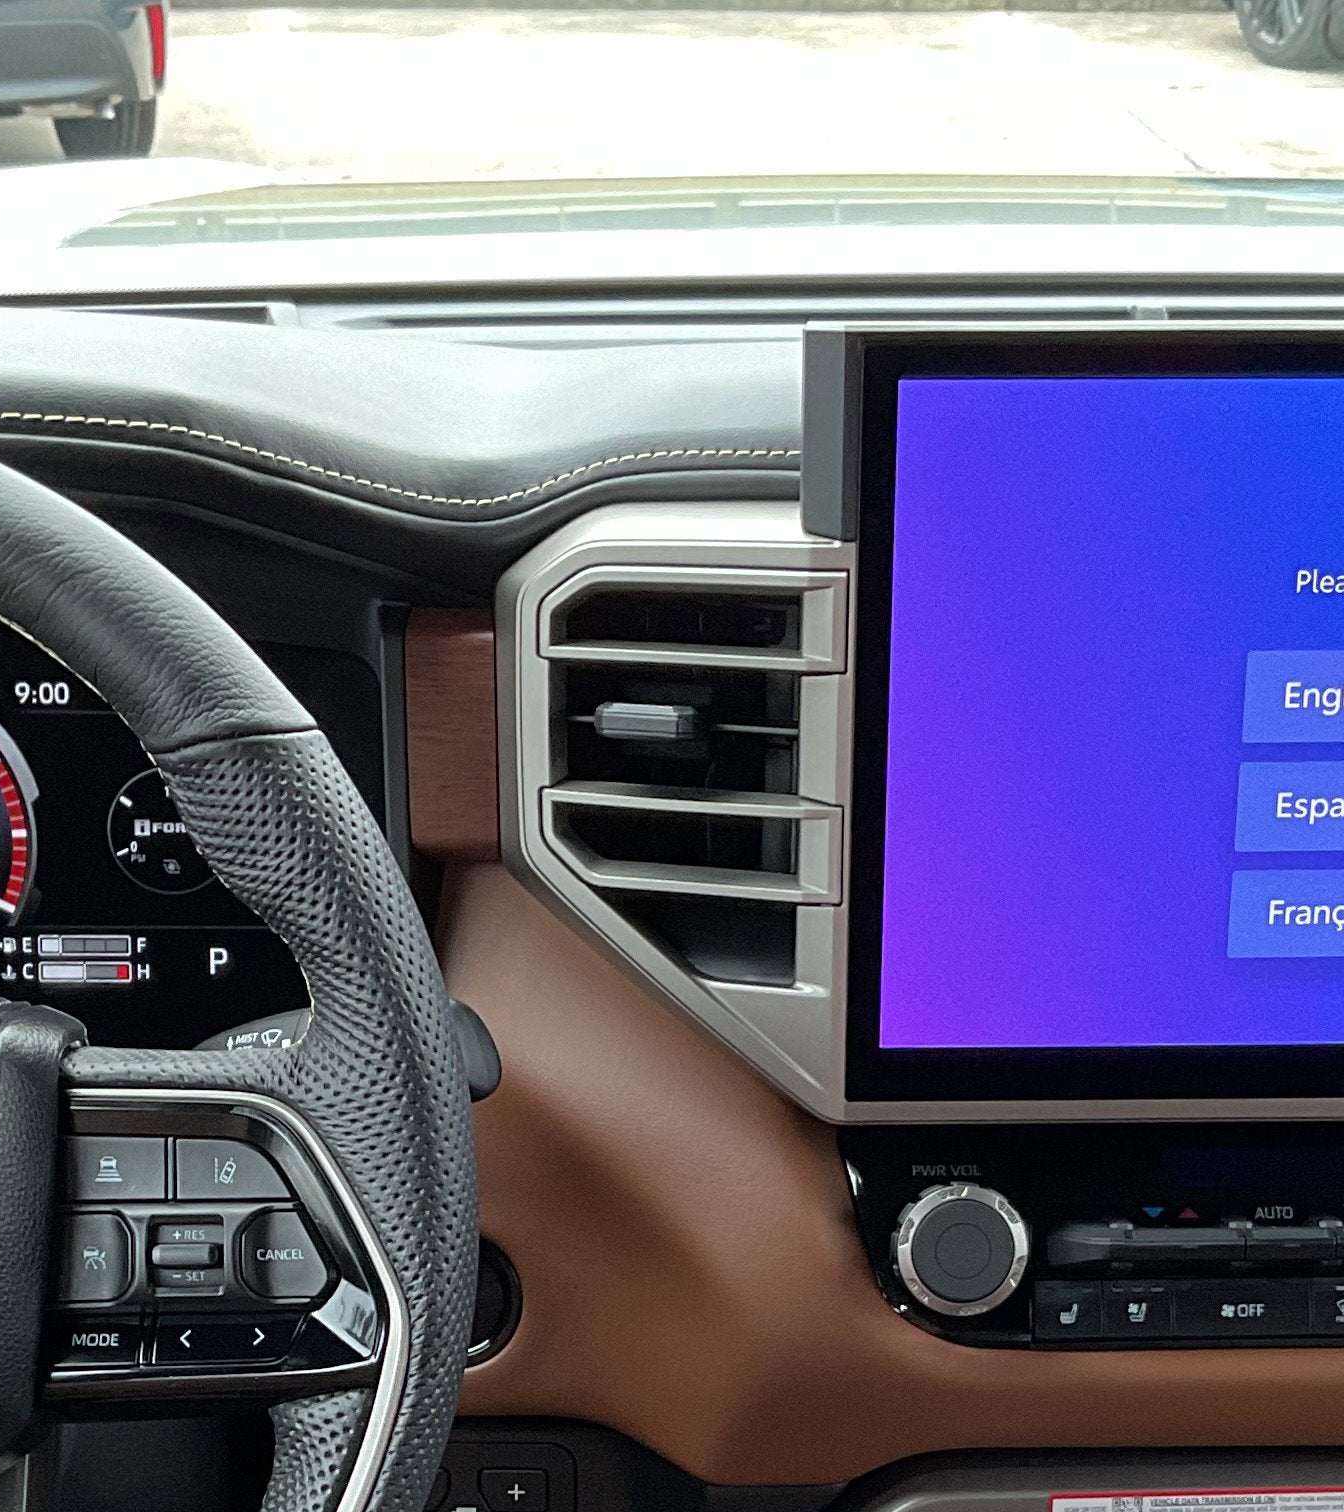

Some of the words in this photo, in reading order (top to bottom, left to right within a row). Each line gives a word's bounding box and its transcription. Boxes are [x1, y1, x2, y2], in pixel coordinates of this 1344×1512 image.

[14, 682, 70, 705] 9:00
[130, 841, 138, 853] 0
[22, 938, 33, 954] E
[136, 938, 147, 954] F
[209, 948, 229, 975] P
[22, 964, 34, 980] C
[138, 964, 150, 980] H
[236, 1032, 259, 1044] MIST
[911, 1164, 947, 1178] PWR
[950, 1163, 982, 1178] VOL
[1255, 1206, 1294, 1220] AUTO
[256, 1248, 305, 1261] CANCEL
[1237, 1304, 1265, 1318] OFF
[71, 1332, 119, 1347] MODE
